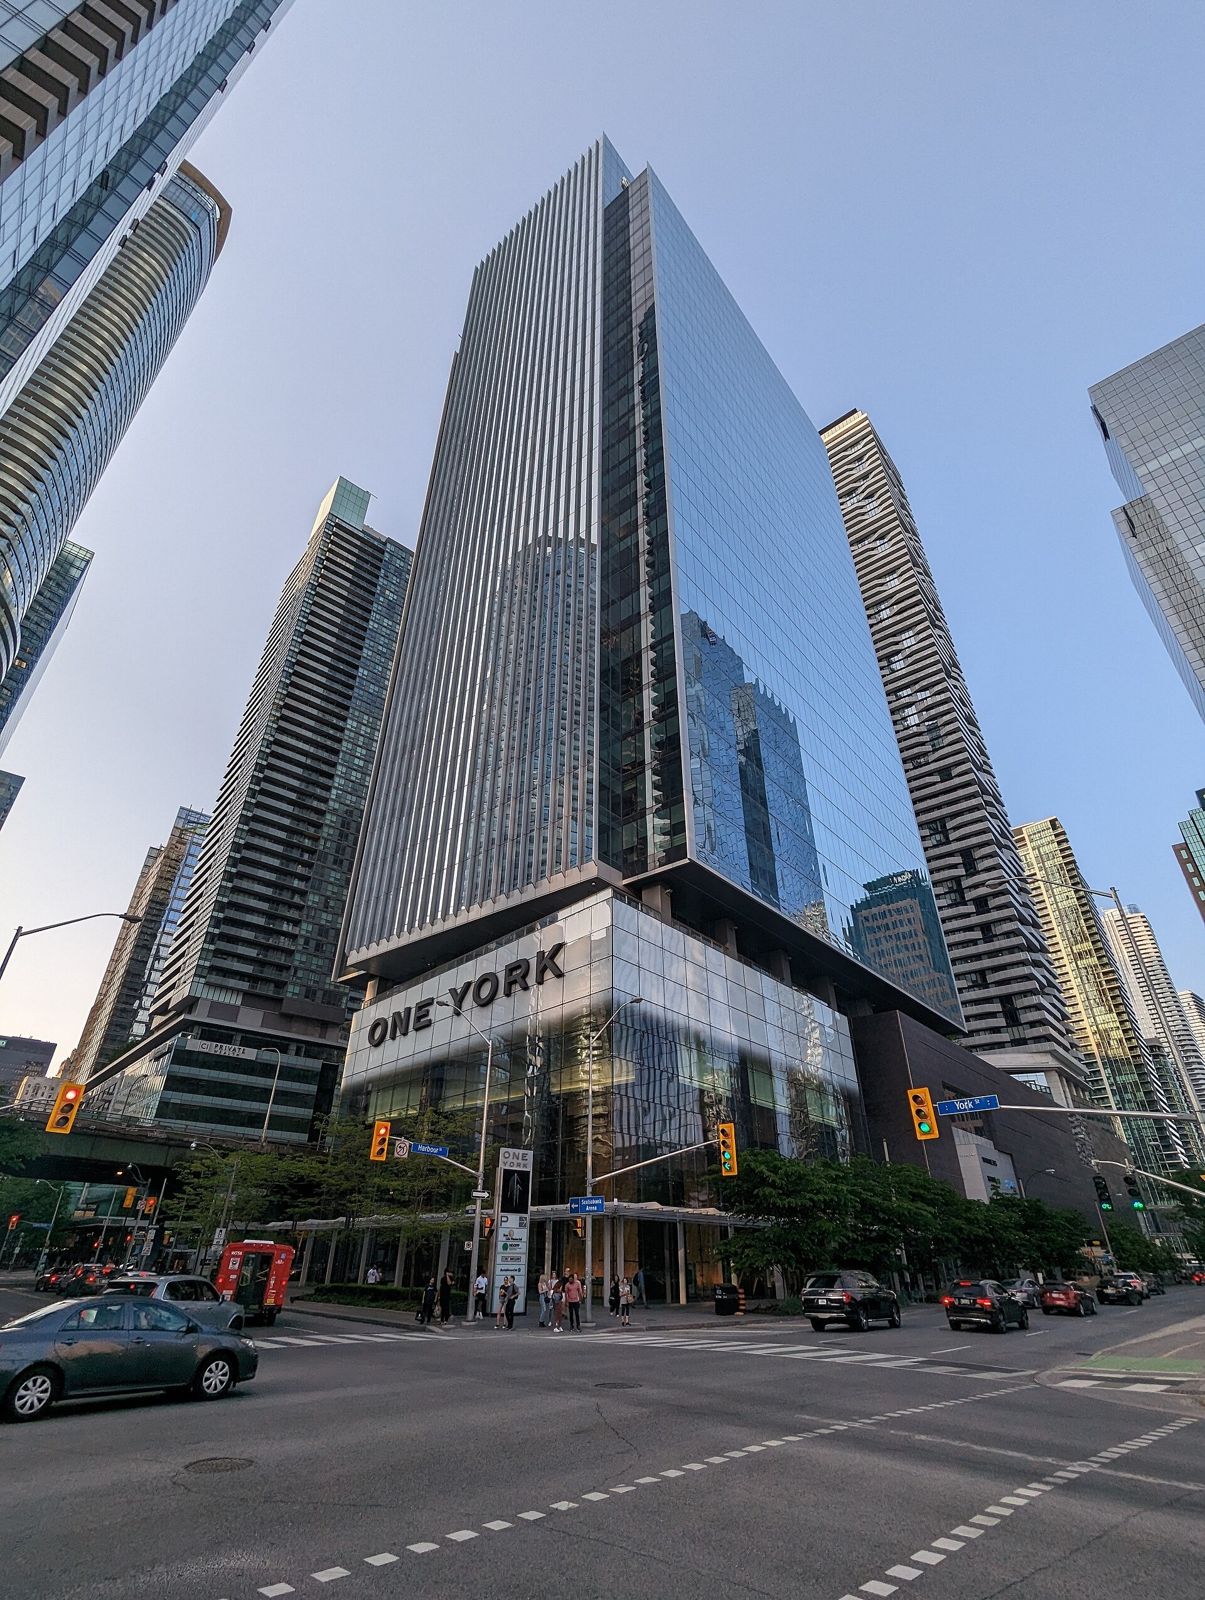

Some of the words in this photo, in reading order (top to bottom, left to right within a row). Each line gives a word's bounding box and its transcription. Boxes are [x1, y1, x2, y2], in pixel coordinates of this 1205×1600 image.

[368, 997, 434, 1047] ONE
[448, 941, 566, 1016] YORK
[214, 1043, 246, 1055] PRIVATE
[954, 1100, 974, 1110] York
[417, 1144, 439, 1154] Harbour
[503, 1151, 528, 1161] ONE
[503, 1161, 528, 1169] YORK
[500, 1216, 509, 1226] P
